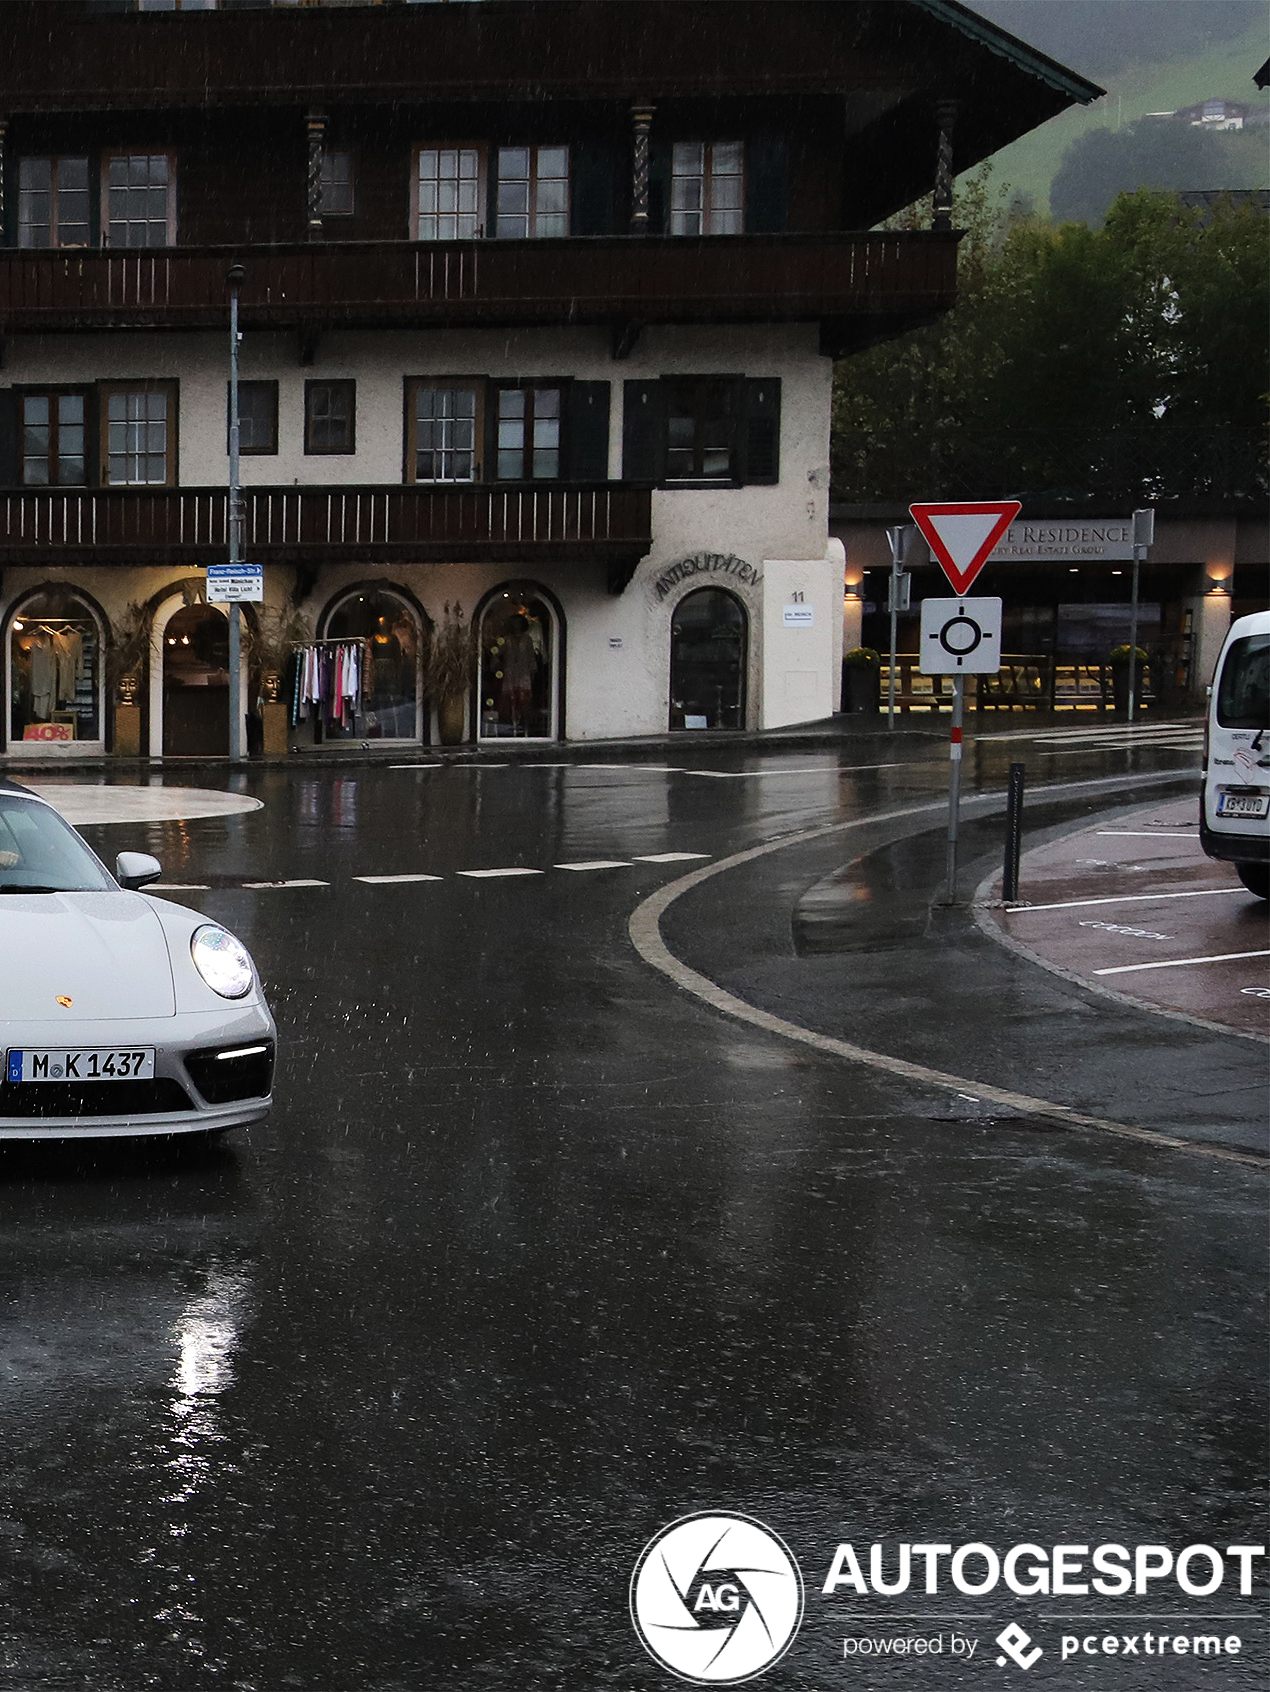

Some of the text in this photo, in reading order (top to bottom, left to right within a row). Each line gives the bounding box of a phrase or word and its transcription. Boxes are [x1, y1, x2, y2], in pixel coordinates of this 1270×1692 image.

[1023, 527, 1128, 543] RESIDENCE
[654, 552, 764, 601] ANTIQUITÄTEN
[791, 591, 804, 603] 11
[23, 726, 70, 741] 40%
[1079, 920, 1175, 940] COCOON
[32, 1052, 146, 1078] M K 1437
